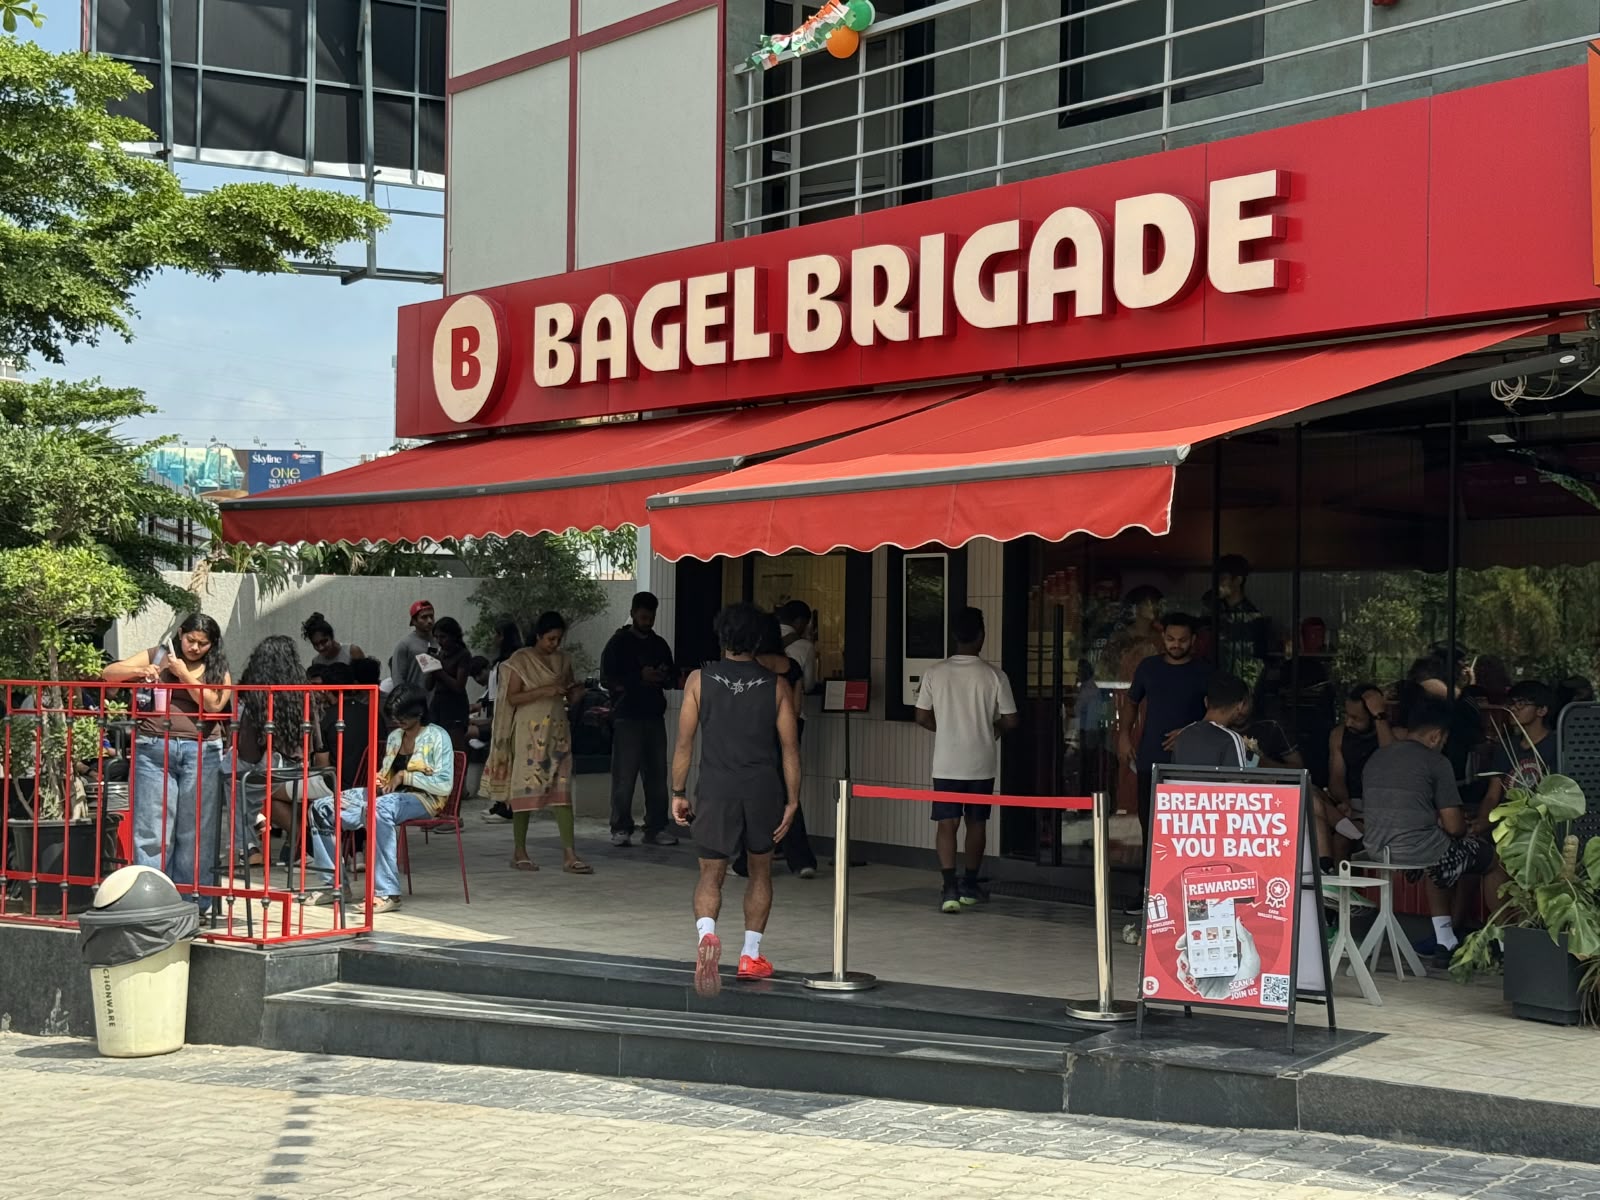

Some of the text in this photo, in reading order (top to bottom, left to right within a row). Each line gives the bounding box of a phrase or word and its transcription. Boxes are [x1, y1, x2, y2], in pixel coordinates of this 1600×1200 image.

[533, 169, 1278, 388] BAGEL BRIGADE
[450, 325, 482, 391] B
[252, 453, 282, 465] Skyline
[1157, 793, 1273, 811] BREAKFAST
[1157, 813, 1287, 835] THAT PAYS
[1171, 838, 1215, 857] YOU
[1189, 878, 1255, 896] REWARDS!!
[1146, 981, 1155, 991] B
[1228, 980, 1249, 989] SCAN
[1230, 988, 1258, 1000] JOIN US
